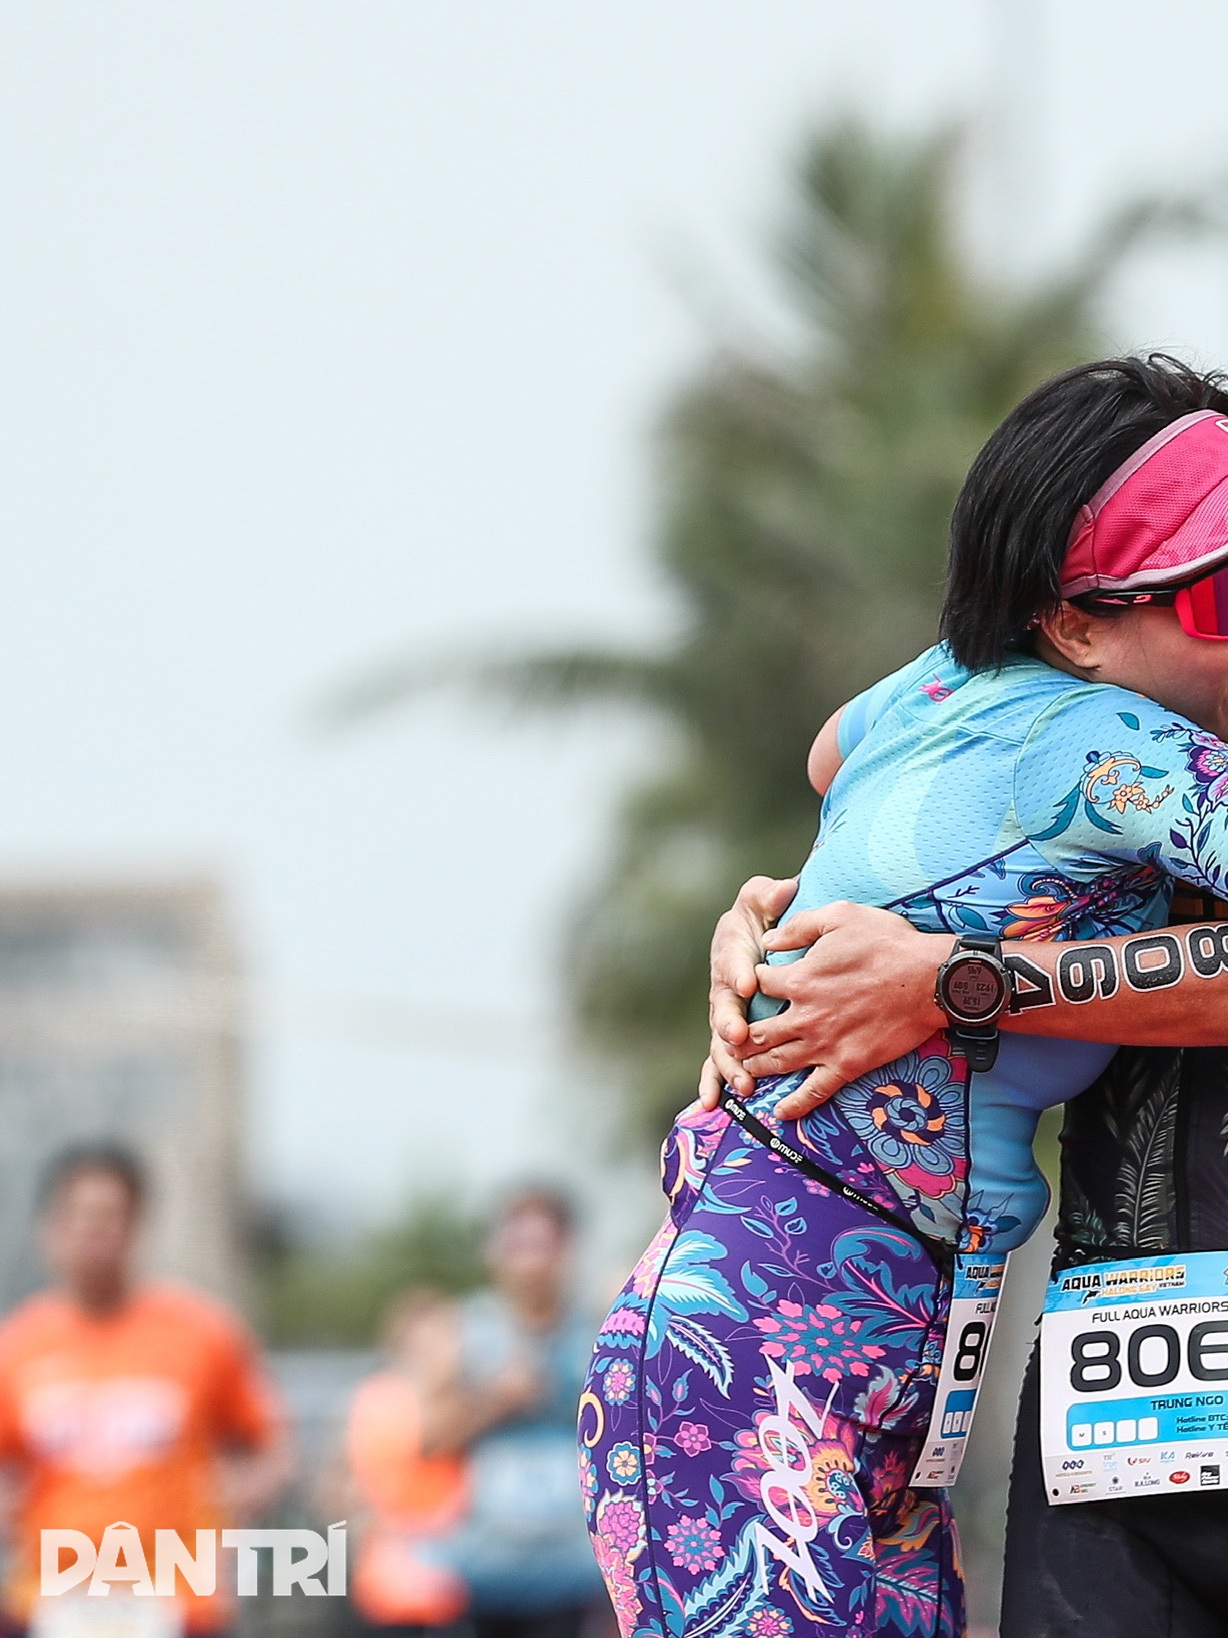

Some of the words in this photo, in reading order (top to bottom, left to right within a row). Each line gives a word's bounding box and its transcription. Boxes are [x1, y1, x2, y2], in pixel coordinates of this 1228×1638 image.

[1061, 1274, 1101, 1292] AQUA
[1105, 1266, 1185, 1286] WARRIORS
[1092, 1310, 1121, 1323] FULL
[1123, 1306, 1156, 1320] AQUA
[953, 1322, 994, 1381] 8
[1151, 1397, 1193, 1411] TRUNG
[1195, 1395, 1224, 1408] NGO
[1176, 1415, 1206, 1424] Hotline
[1176, 1424, 1207, 1434] Hotline
